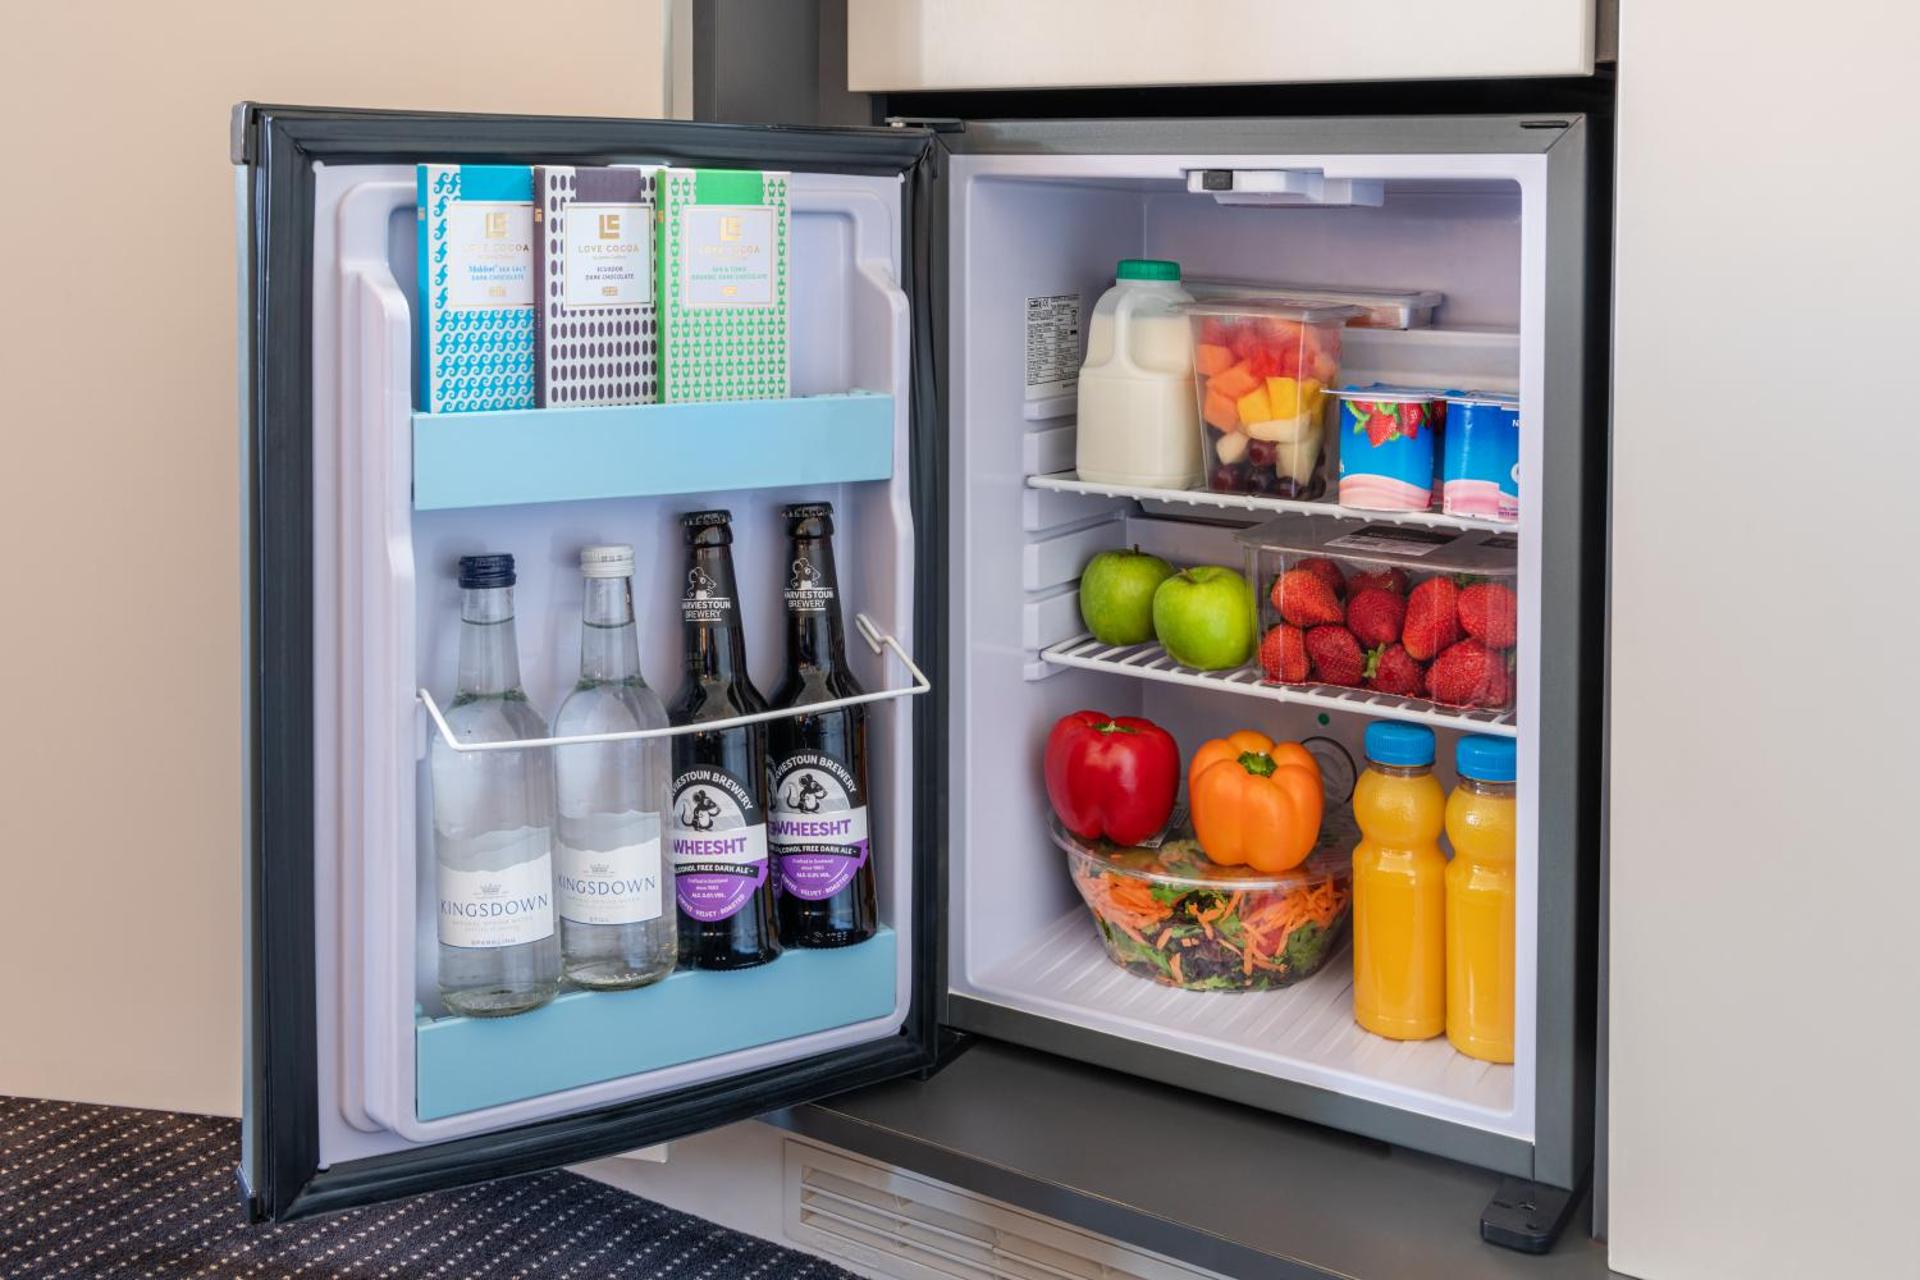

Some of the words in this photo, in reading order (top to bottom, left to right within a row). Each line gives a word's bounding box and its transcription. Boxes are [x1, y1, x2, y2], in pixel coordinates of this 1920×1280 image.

[578, 244, 603, 253] LOVE
[606, 244, 640, 253] COCOA
[788, 600, 826, 608] BREWERY
[685, 609, 722, 619] BREWERY
[819, 757, 857, 793] BREWERY
[712, 772, 754, 810] BREWERY
[777, 819, 852, 837] WHEESHT
[673, 837, 747, 856] WHEESHT
[802, 845, 819, 853] FREE
[840, 847, 852, 855] ALE
[697, 864, 714, 872] FREE
[714, 865, 734, 873] DARK
[735, 866, 748, 874] ALE
[440, 895, 548, 918] KINGSDOWN
